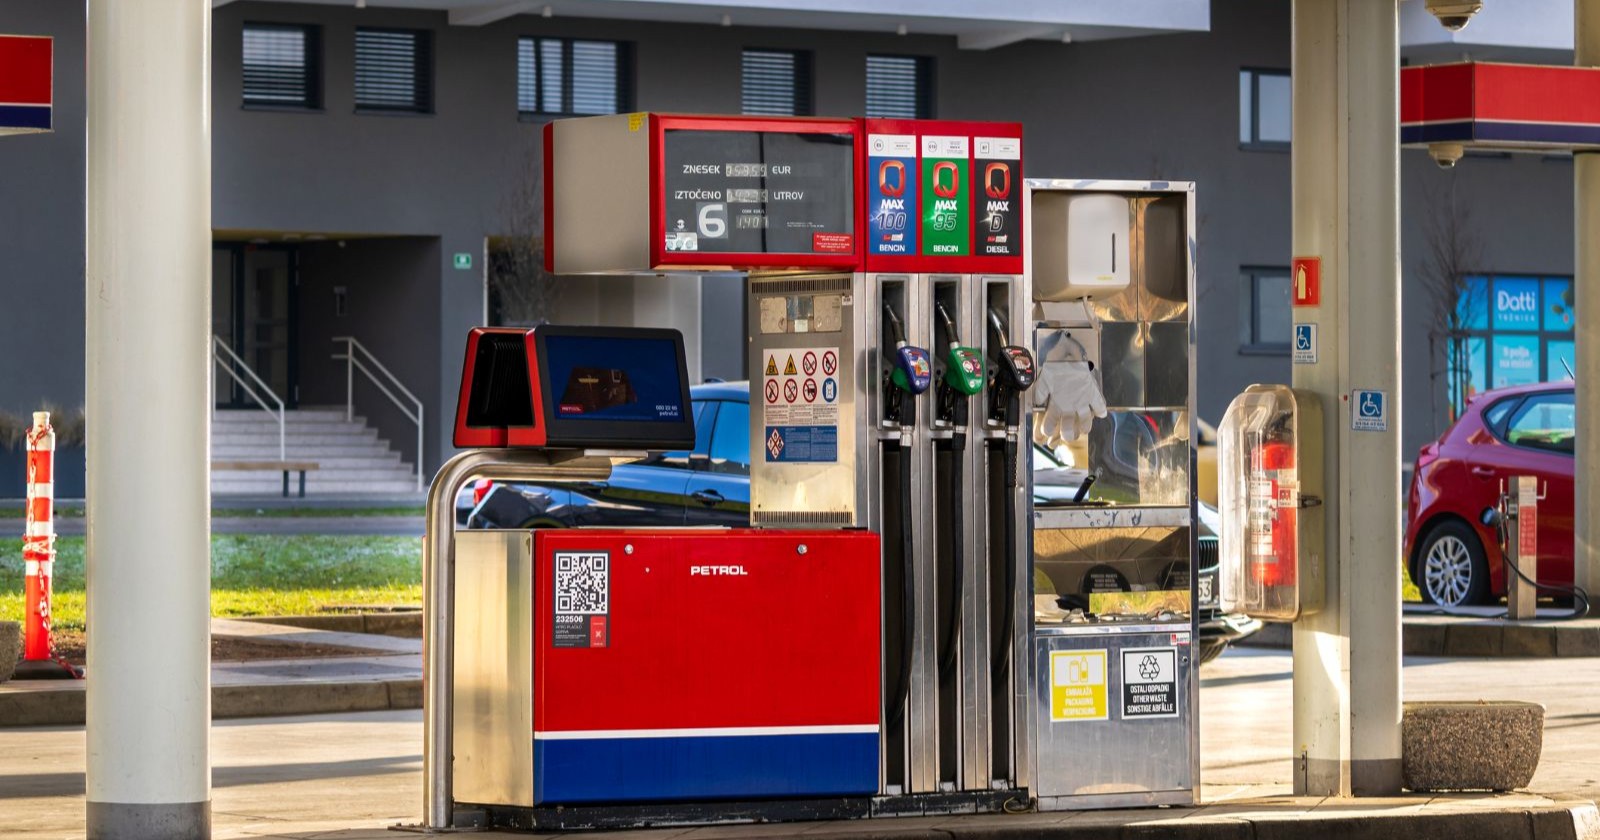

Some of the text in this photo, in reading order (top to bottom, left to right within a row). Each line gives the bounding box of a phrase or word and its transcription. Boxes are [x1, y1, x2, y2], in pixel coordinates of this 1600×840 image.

[682, 164, 721, 174] ZNESEK
[772, 165, 791, 175] EUR
[879, 160, 905, 197] Q
[933, 160, 959, 199] Q
[984, 162, 1011, 200] Q
[674, 188, 721, 200] IZTOČENO
[774, 191, 804, 200] LITROV
[881, 199, 904, 209] MAX
[935, 200, 957, 210] MAX
[987, 201, 1009, 211] MAX
[698, 204, 726, 239] 6
[877, 212, 907, 230] 100
[933, 213, 957, 231] 95
[990, 214, 1004, 232] D
[880, 244, 905, 252] BENCIN
[933, 244, 958, 252] BENCIN
[987, 245, 1009, 253] DIESEL
[1498, 290, 1535, 311] Datti
[690, 565, 748, 576] PETROL
[555, 615, 584, 623] 232506
[1130, 683, 1169, 693] OSTALI ODPADKI
[1132, 694, 1167, 703] OTHER WASTE
[1127, 703, 1173, 713] SONSTIGE ABFÄLLE
